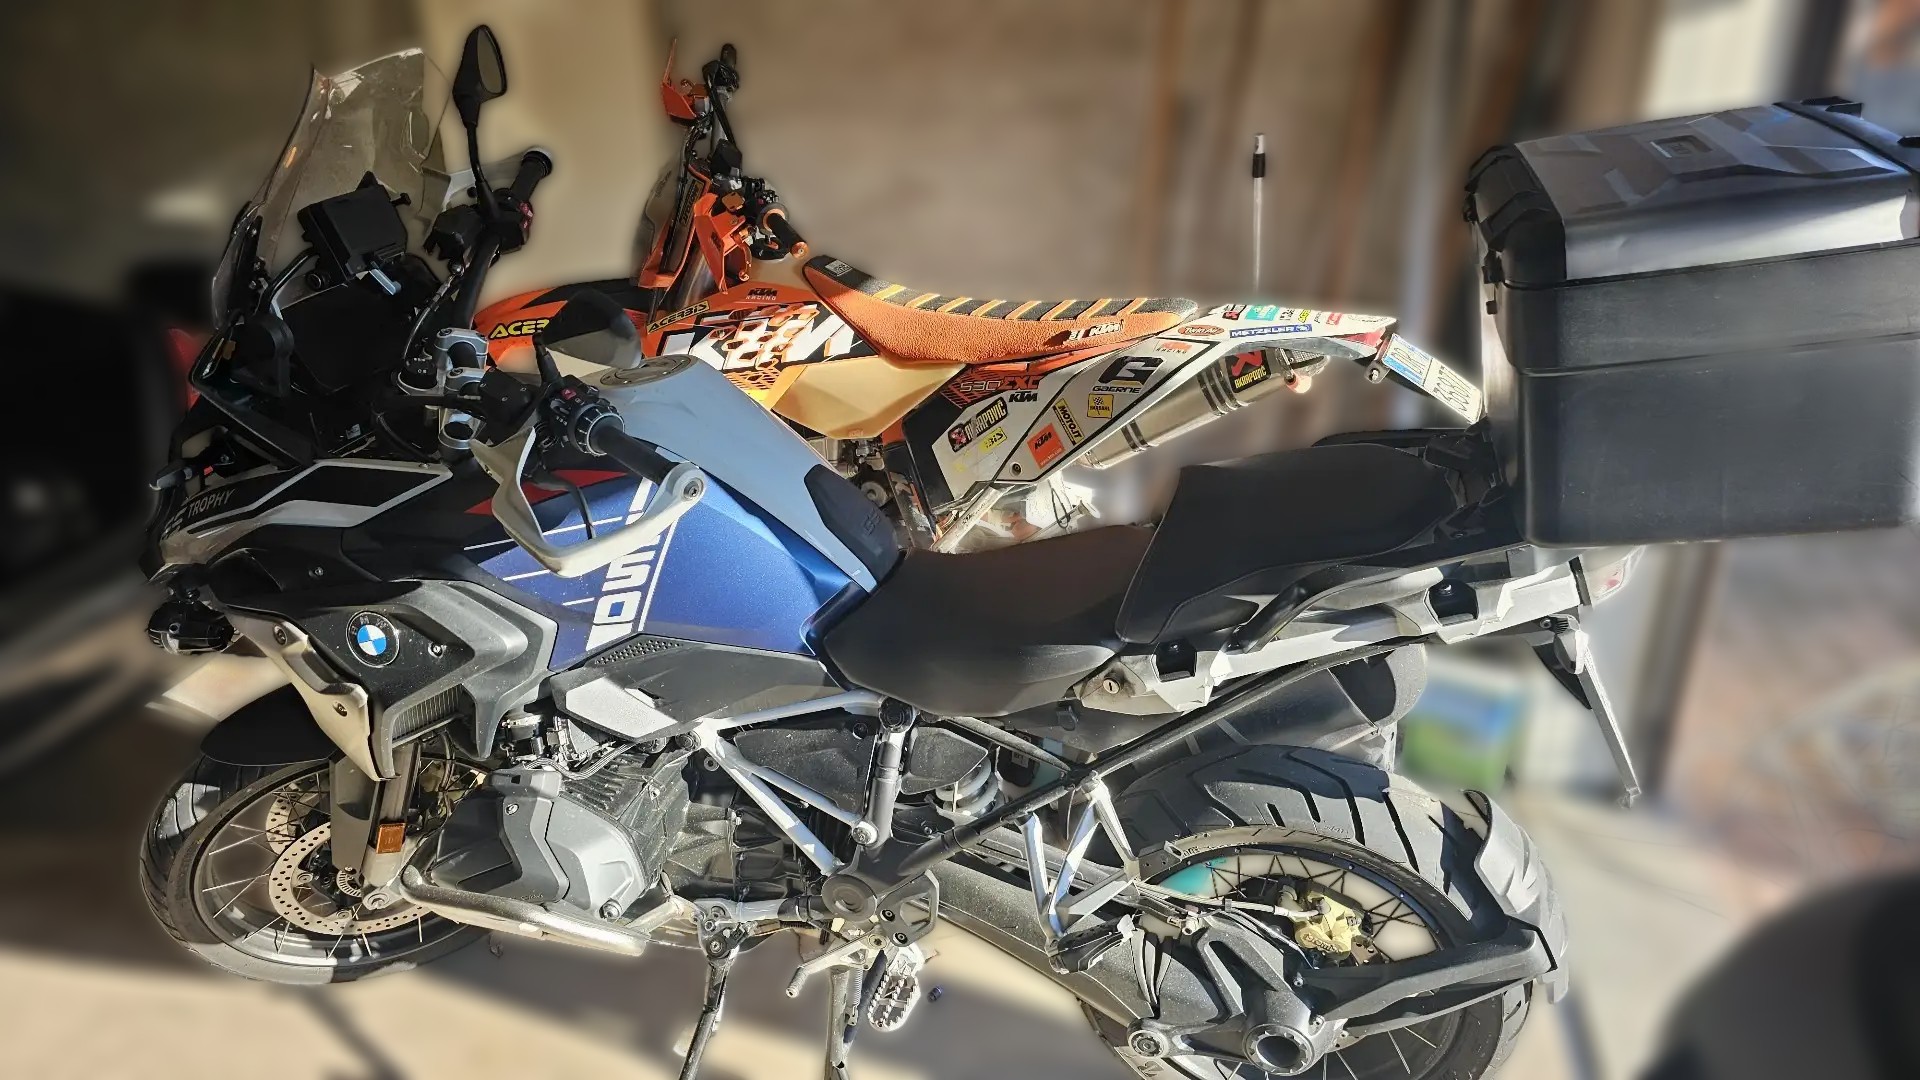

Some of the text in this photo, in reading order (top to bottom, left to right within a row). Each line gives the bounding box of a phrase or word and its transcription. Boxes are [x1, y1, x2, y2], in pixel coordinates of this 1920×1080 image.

[1231, 325, 1294, 337] METZELER
[1008, 391, 1038, 402] KTM
[1033, 432, 1052, 450] KTM
[188, 488, 236, 519] TROPHY
